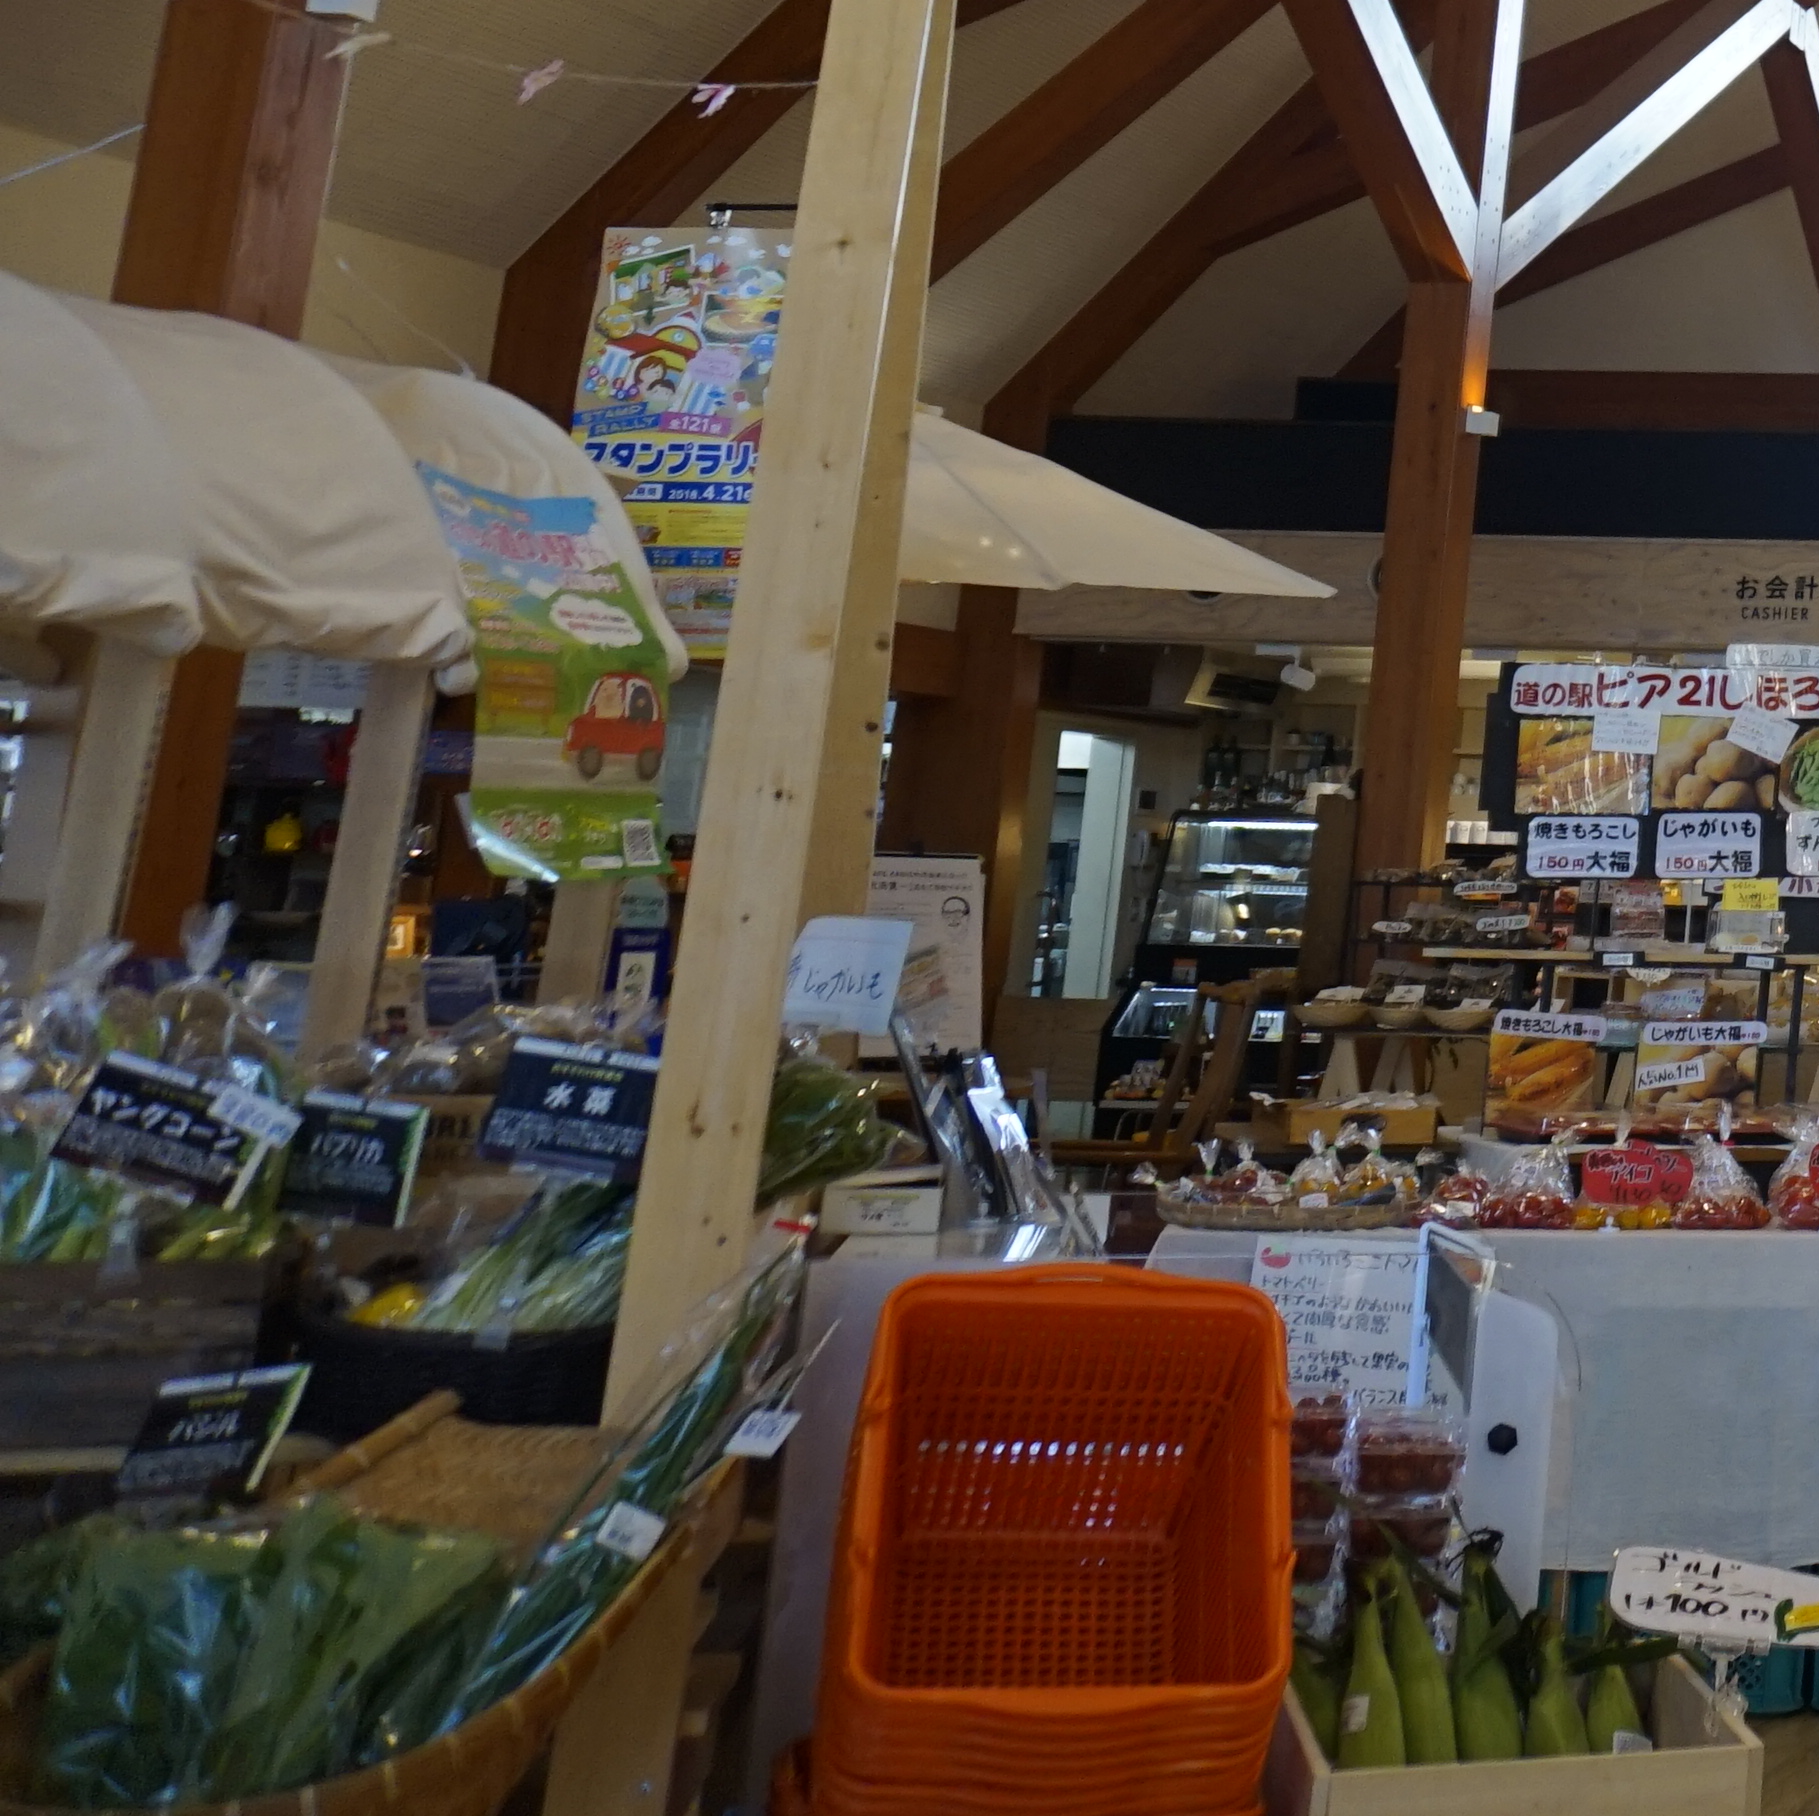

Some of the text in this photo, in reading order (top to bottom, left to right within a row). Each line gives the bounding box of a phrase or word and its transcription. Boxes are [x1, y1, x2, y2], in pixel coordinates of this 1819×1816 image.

[585, 441, 758, 477] スタンプラリ
[1736, 575, 1819, 600] お会計
[1741, 607, 1809, 620] CASHIER
[1534, 821, 1637, 840] 焼きもろこし
[1662, 819, 1757, 840] じゃがいも
[1651, 1025, 1741, 1041] じゃがいも大福
[90, 1087, 241, 1151] ヤングコーン
